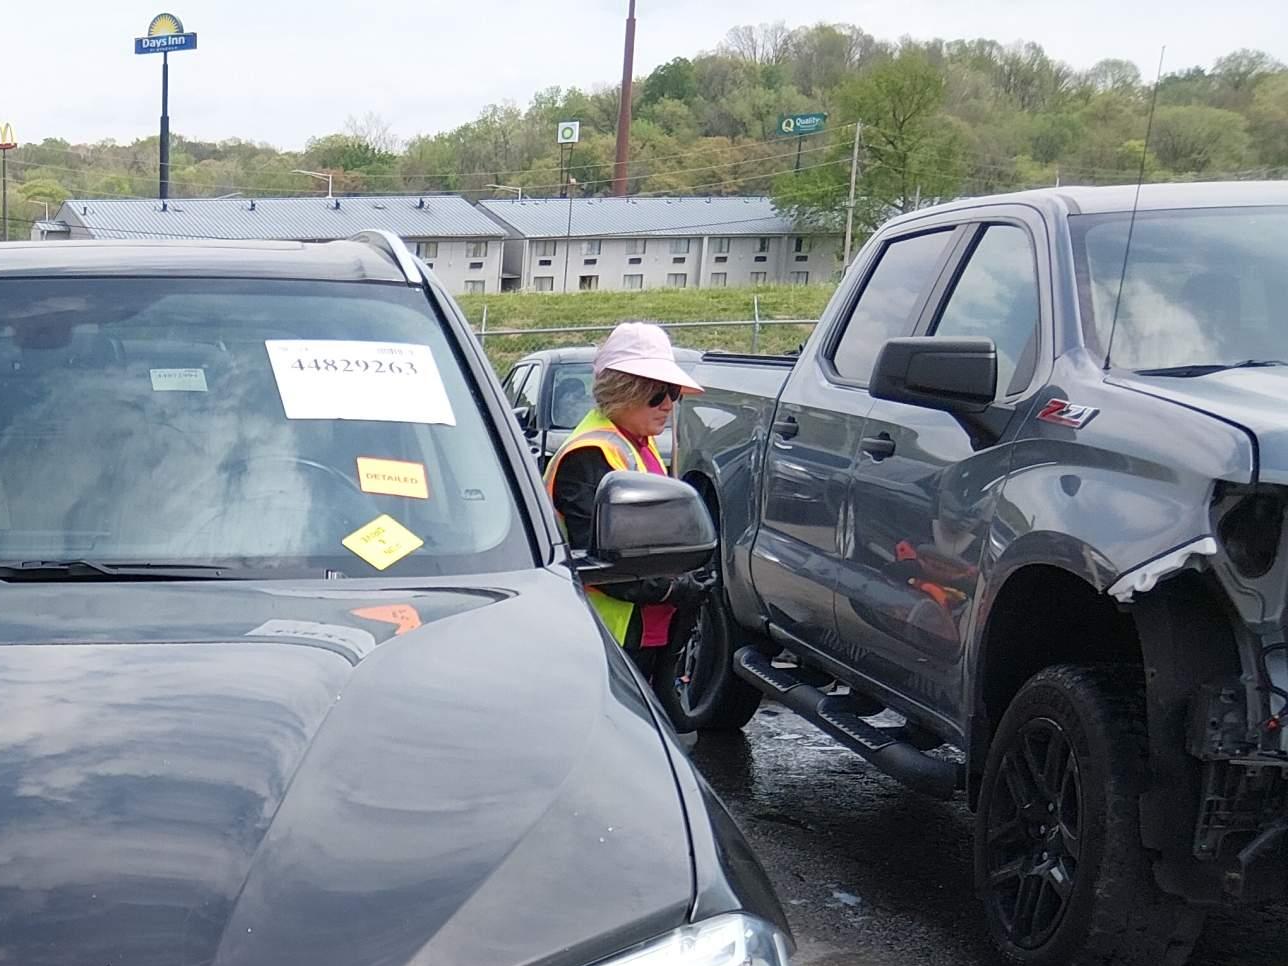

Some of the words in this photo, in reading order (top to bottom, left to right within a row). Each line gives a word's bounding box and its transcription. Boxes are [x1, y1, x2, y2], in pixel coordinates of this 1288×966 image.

[142, 38, 167, 48] Days
[168, 36, 185, 45] Inn
[290, 358, 418, 375] 44829263
[1036, 398, 1100, 429] Z71
[365, 472, 419, 485] DETAILED
